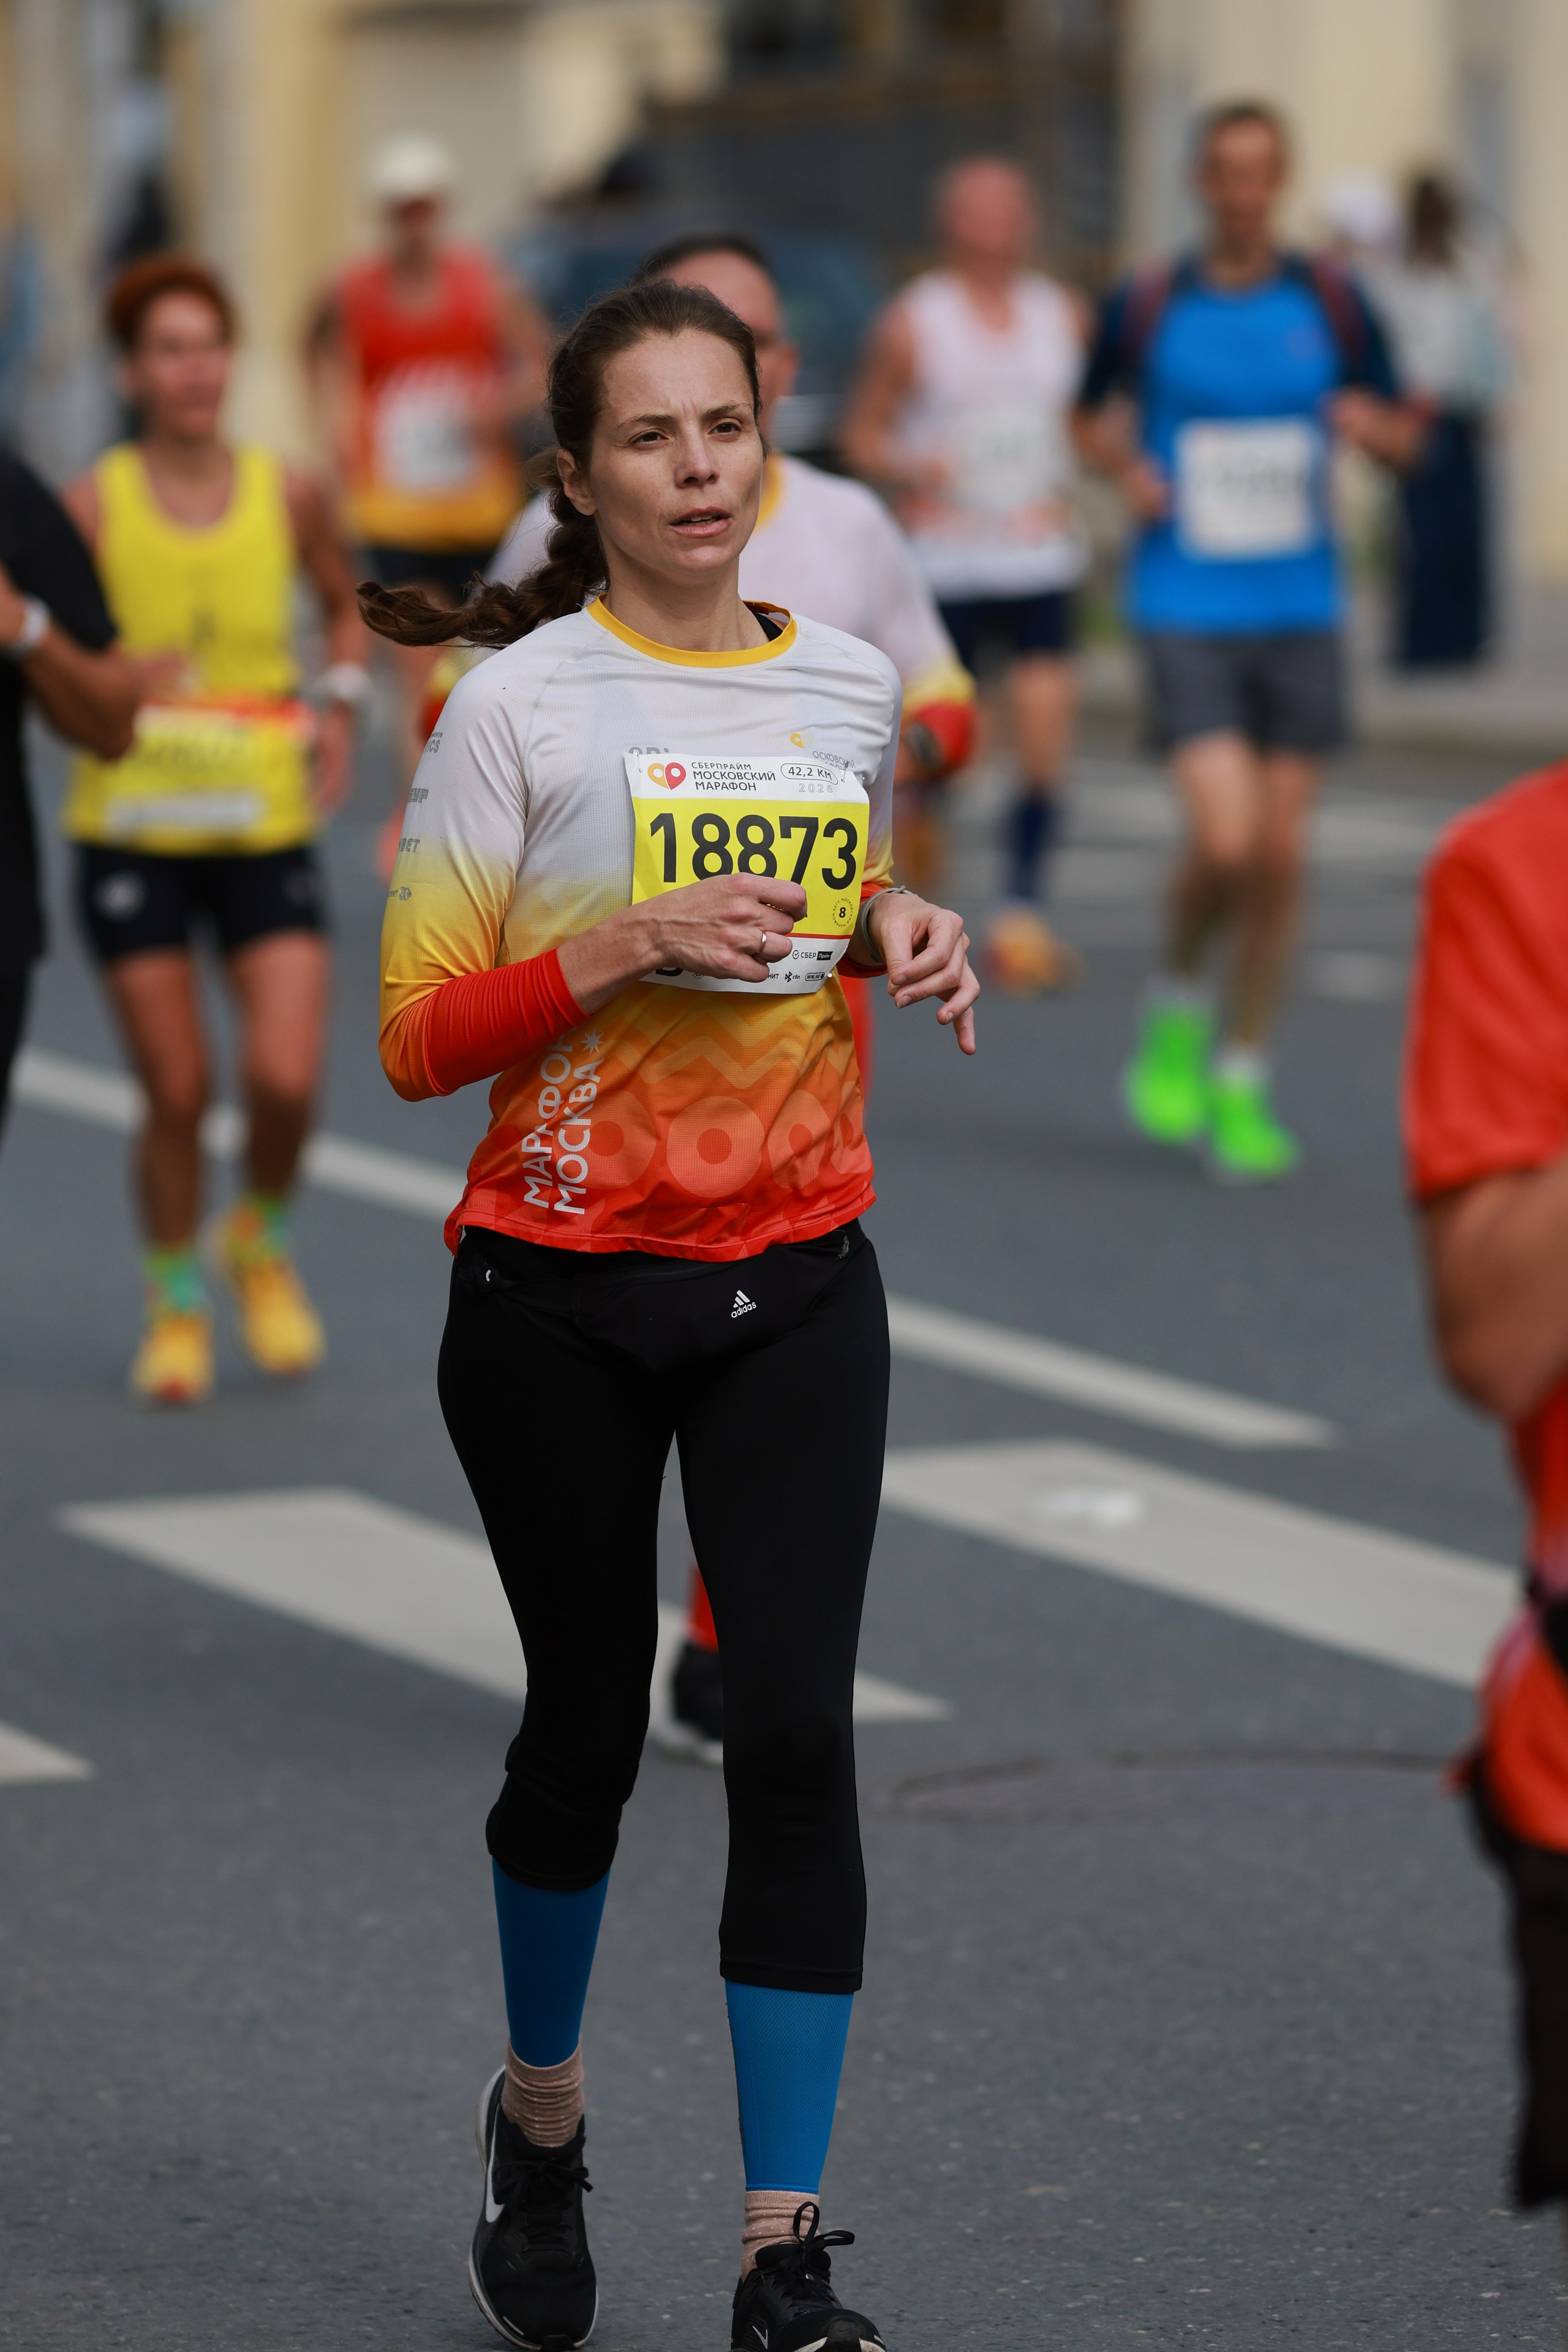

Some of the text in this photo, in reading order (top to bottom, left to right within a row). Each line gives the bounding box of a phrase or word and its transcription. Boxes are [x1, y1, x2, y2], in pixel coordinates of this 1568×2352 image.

[693, 771, 776, 781] МОСКОВСКИЙ
[788, 767, 832, 780] 42,2 КМ
[695, 782, 756, 791] МАРАФОН
[799, 783, 833, 793] 2026
[399, 838, 421, 853] BET
[650, 812, 858, 891] 18873
[839, 907, 846, 918] 8
[554, 1058, 605, 1215] МОСКВА
[731, 1302, 756, 1318] adidas
